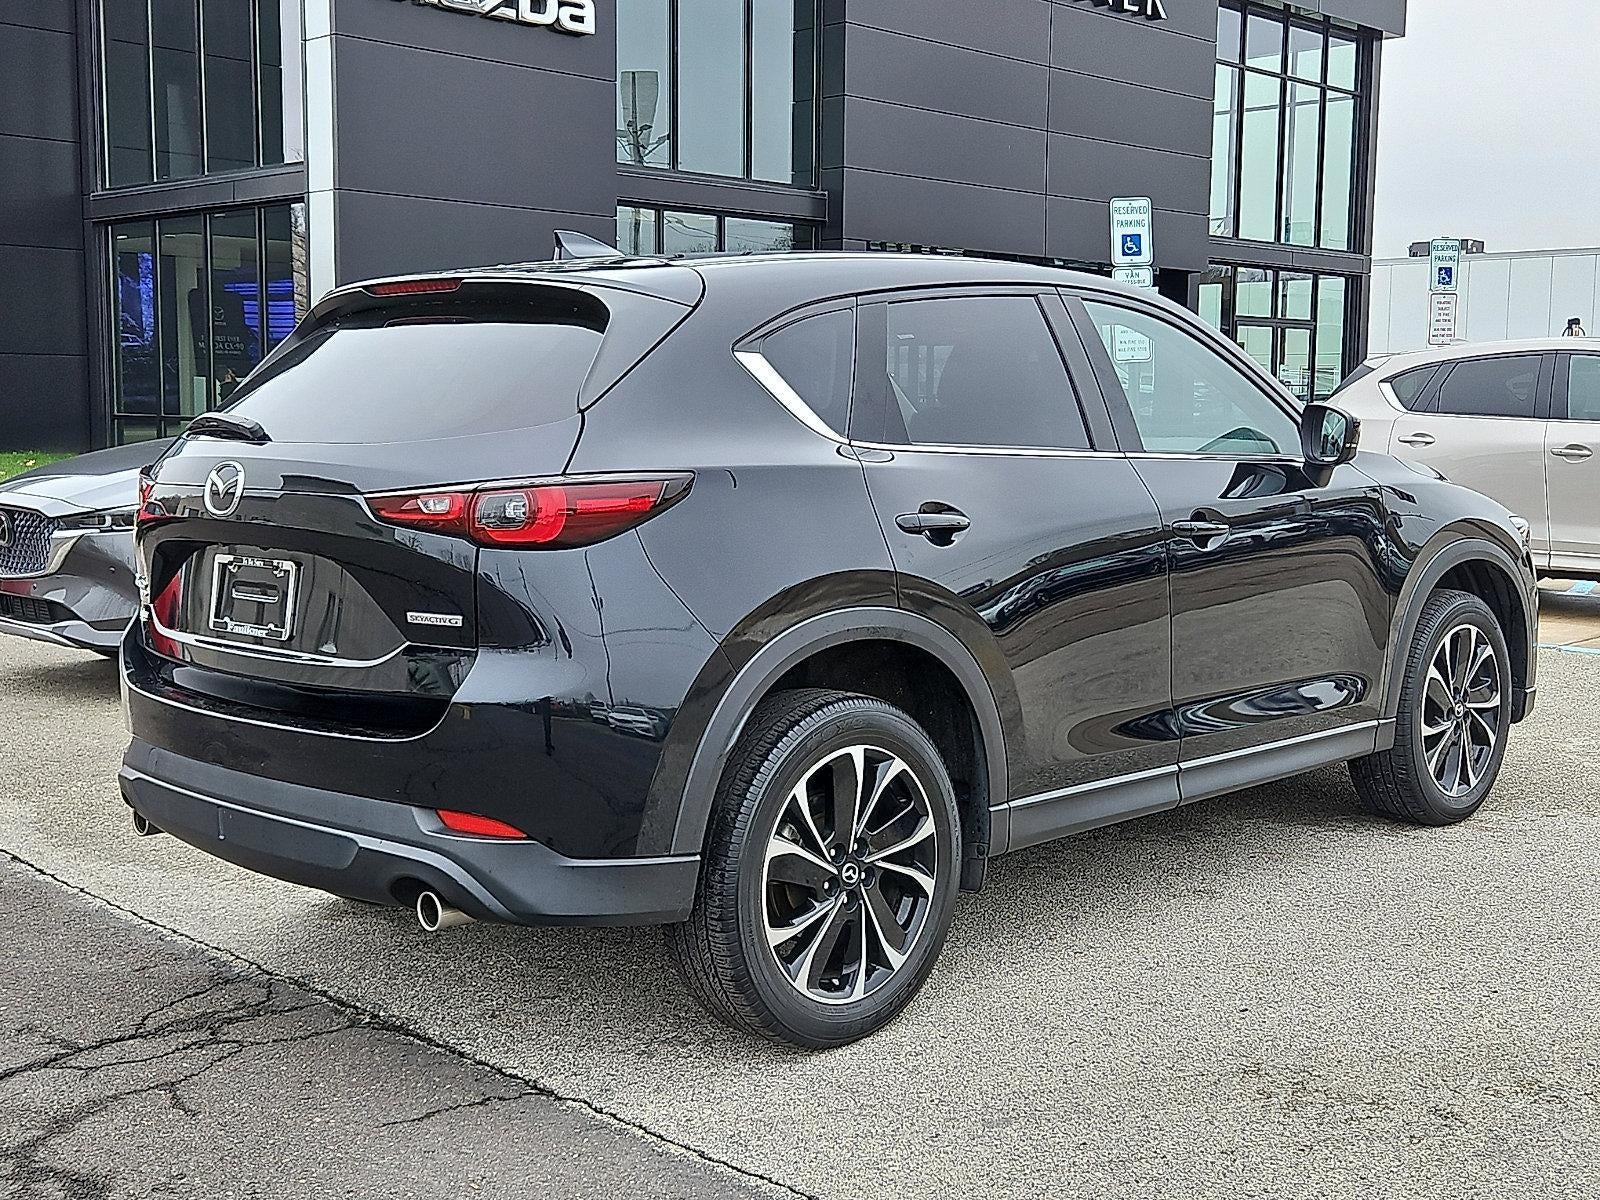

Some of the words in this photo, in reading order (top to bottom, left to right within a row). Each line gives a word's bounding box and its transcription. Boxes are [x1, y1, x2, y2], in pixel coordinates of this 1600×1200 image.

[1113, 206, 1148, 215] RESERVED
[1116, 219, 1146, 228] PARKING
[1433, 244, 1458, 252] RESERVED
[1125, 271, 1140, 279] VAN
[409, 614, 448, 624] SKYACTIV
[227, 622, 269, 638] Faulkner
